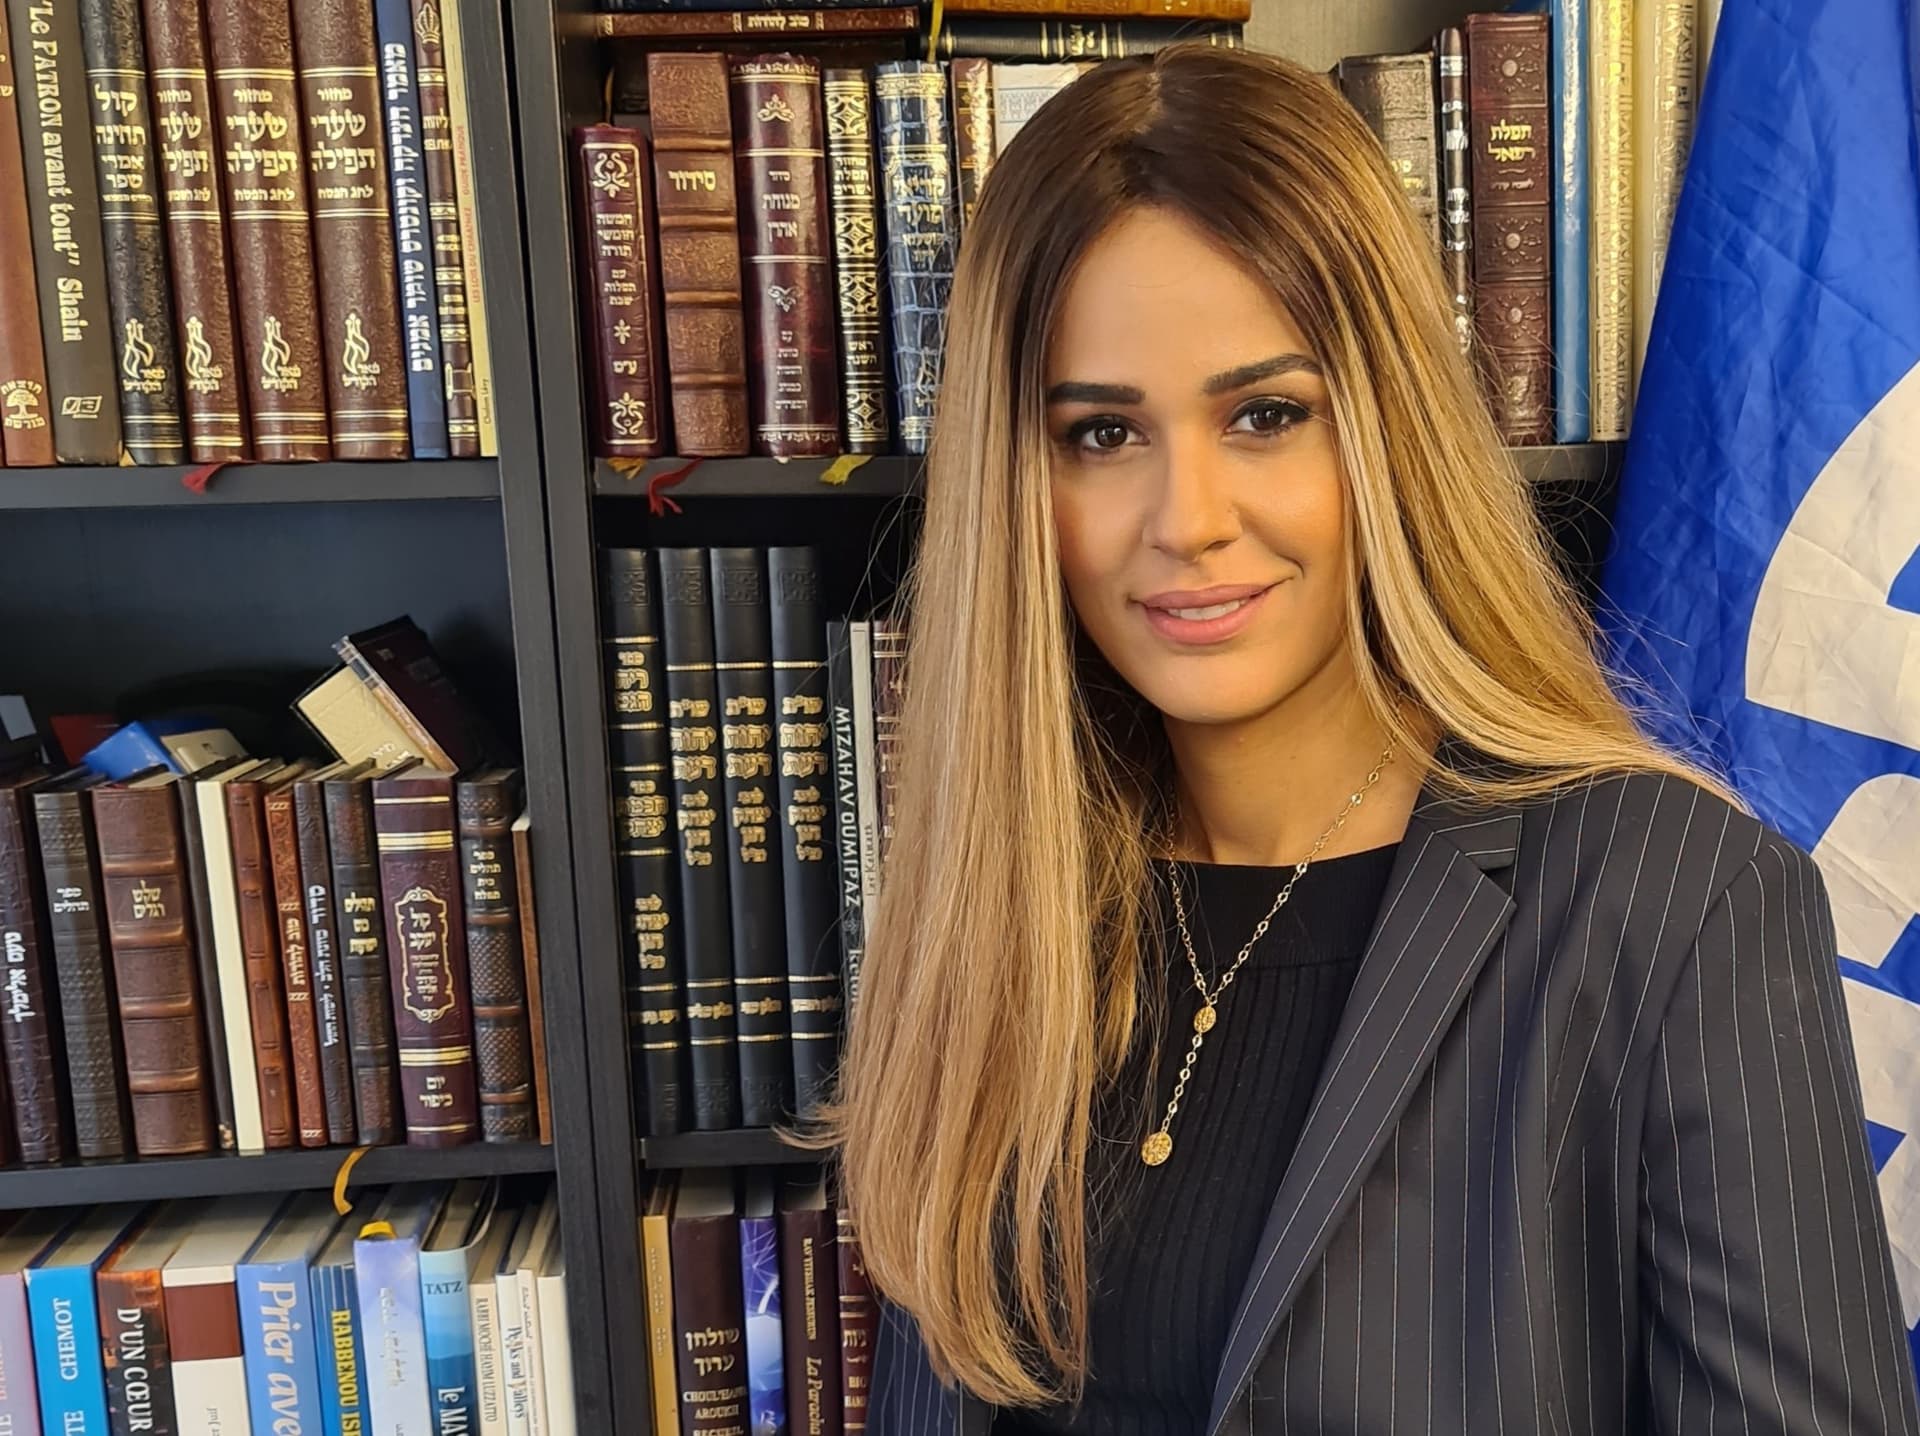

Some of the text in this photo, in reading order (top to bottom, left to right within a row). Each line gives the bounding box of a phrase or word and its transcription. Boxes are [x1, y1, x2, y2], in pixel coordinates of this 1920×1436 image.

[33, 40, 63, 128] PATRON
[384, 43, 409, 100] מאמר
[95, 83, 138, 117] קול
[157, 89, 192, 103] מחזור
[233, 88, 273, 102] מחזור
[317, 87, 353, 101] מחזור
[96, 125, 146, 144] תחינה
[161, 111, 202, 142] שער
[226, 110, 288, 141] שערי
[310, 108, 366, 140] שערי
[1491, 118, 1532, 141] תפלת
[41, 131, 67, 198] avant
[101, 155, 144, 169] אמרי
[163, 143, 208, 177] תפיל
[226, 142, 297, 177] תפילה
[311, 141, 376, 175] תפילה
[106, 174, 142, 188] שפר
[234, 187, 296, 201] לחג הפסח
[317, 184, 374, 199] לחג הפסח
[460, 168, 471, 196] GUIDE
[668, 170, 716, 191] סידור
[601, 245, 632, 257] תורה
[403, 259, 426, 309] שומר
[57, 277, 87, 343] Shain
[407, 314, 434, 372] אמונים
[848, 341, 874, 351] ראש
[840, 812, 861, 908] OUMIPAZ
[308, 885, 328, 924] סדור
[4, 968, 36, 1023] אלימלך
[424, 1280, 464, 1295] TATZ
[53, 1297, 79, 1381] CHEMOT
[684, 1327, 741, 1351] שולחן
[258, 1280, 303, 1436] Prier ave
[331, 1310, 360, 1407] RABBENOU
[510, 1361, 526, 1379] and
[693, 1354, 735, 1377] ערוך
[123, 1365, 154, 1433] CŒUR
[438, 1385, 466, 1404] Le
[483, 1381, 498, 1423] LUZZATTO
[507, 1379, 528, 1419] Valleys
[806, 1356, 825, 1436] La Paracha
[207, 1407, 219, 1426] Juif
